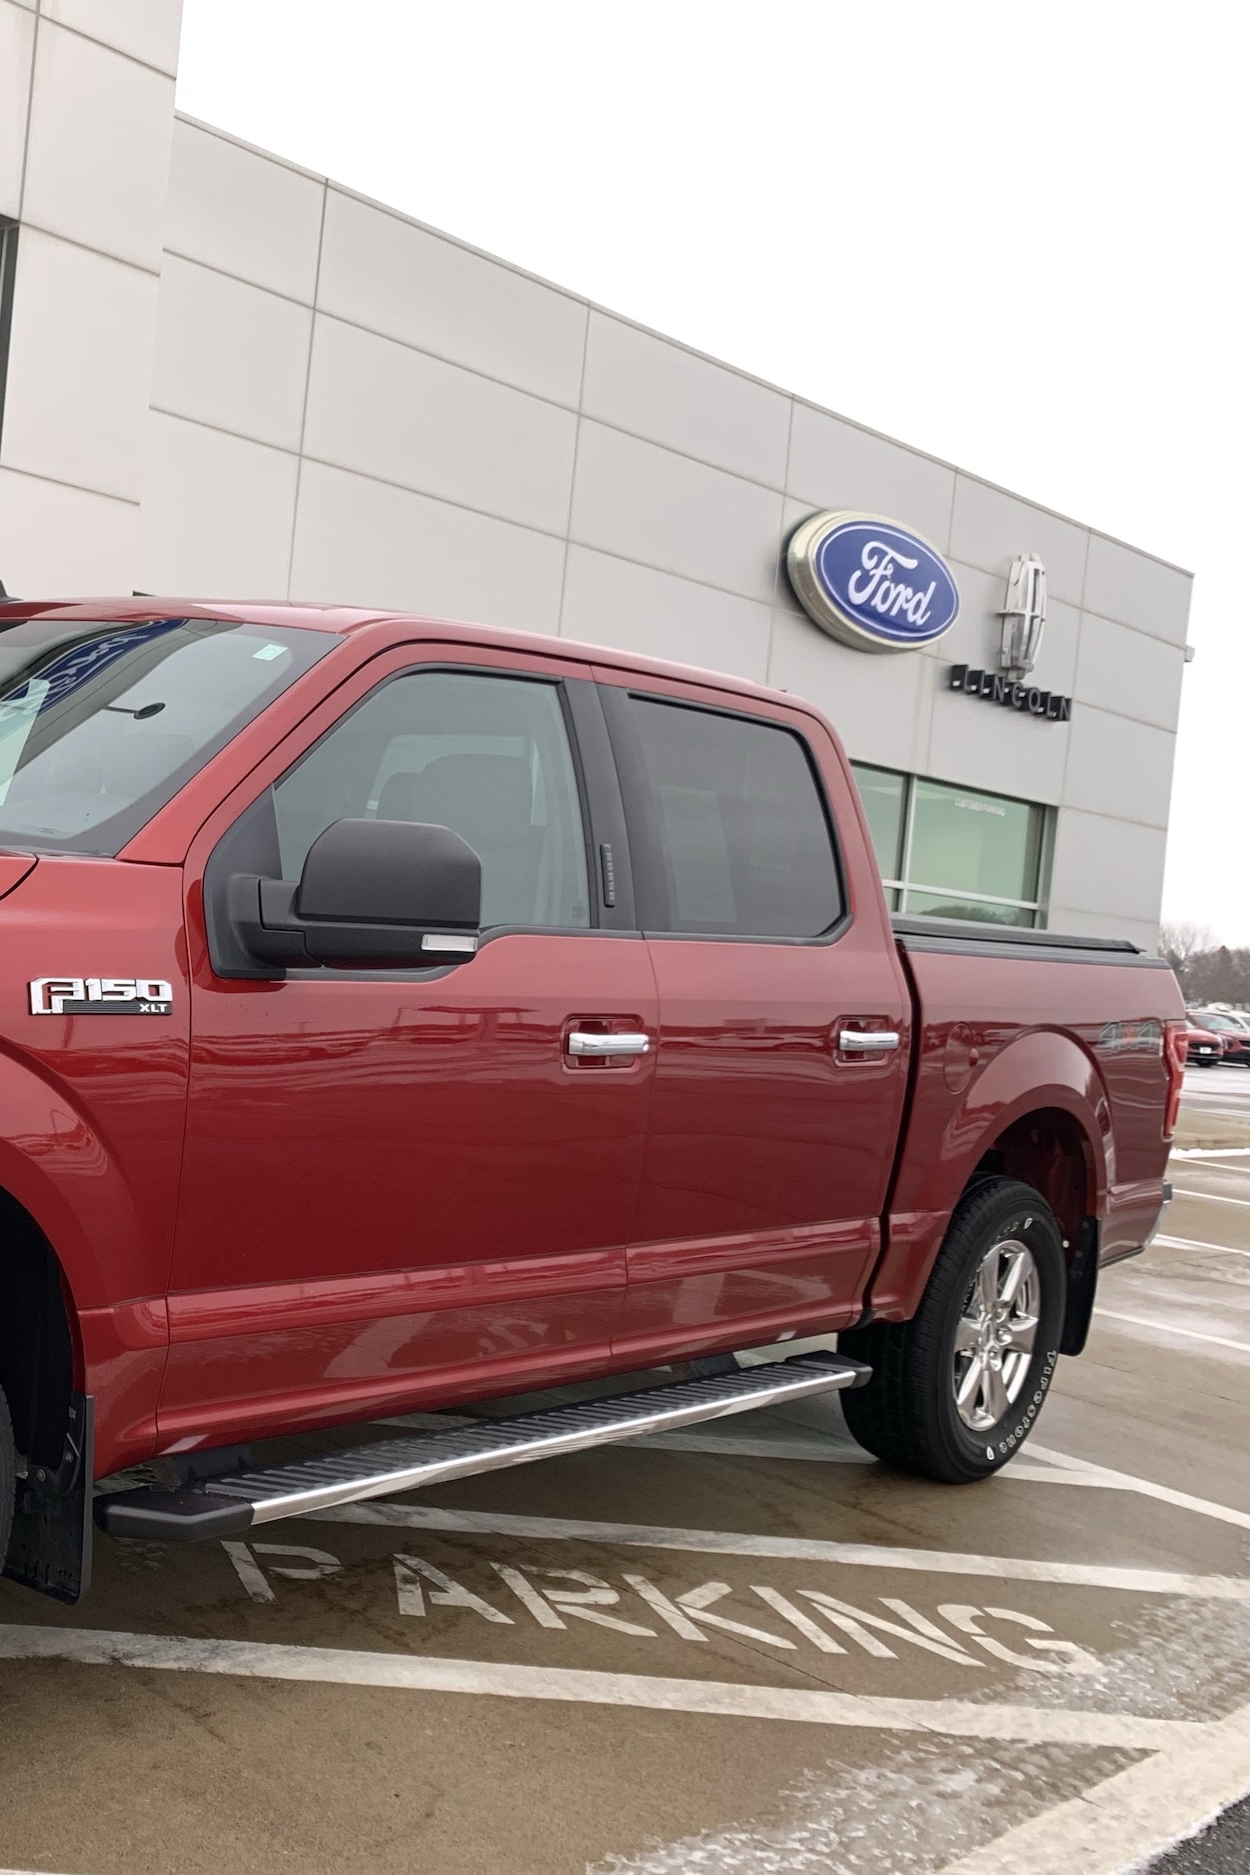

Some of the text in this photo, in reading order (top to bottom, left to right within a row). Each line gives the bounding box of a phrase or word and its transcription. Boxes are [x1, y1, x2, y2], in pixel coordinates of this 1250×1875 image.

[848, 541, 936, 626] Ford
[950, 664, 1072, 721] LINCOLN
[138, 1003, 168, 1013] XLT
[221, 1540, 1104, 1676] PARKING
